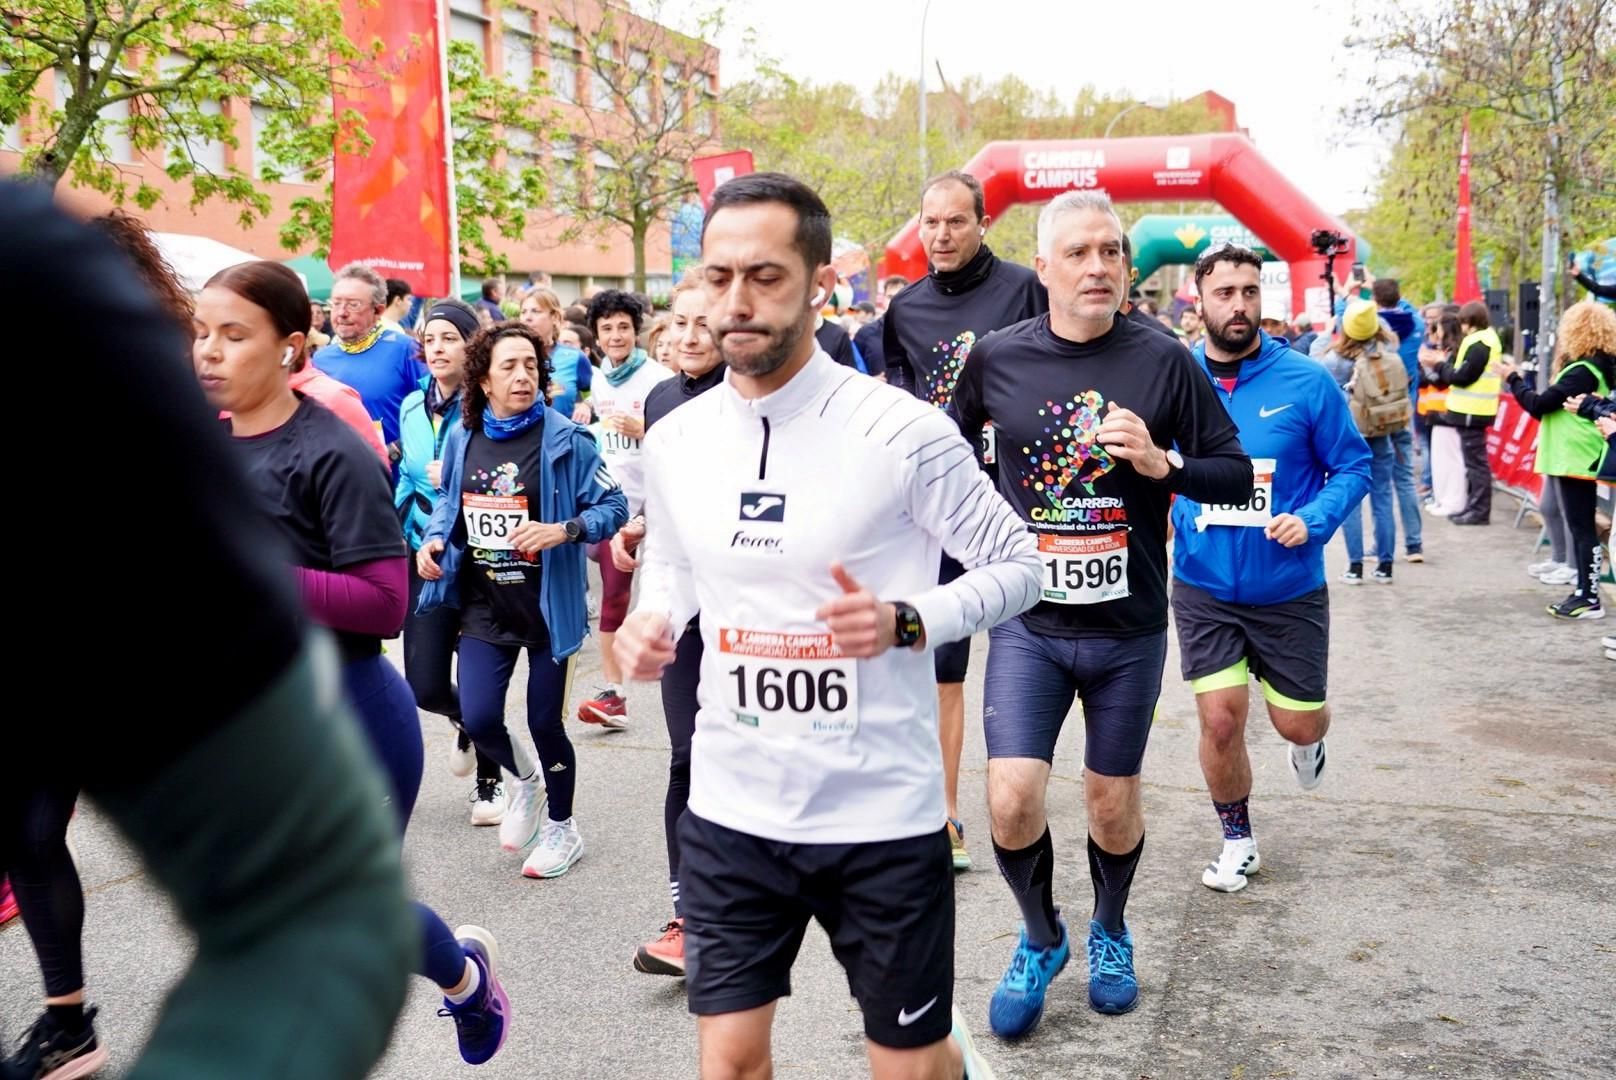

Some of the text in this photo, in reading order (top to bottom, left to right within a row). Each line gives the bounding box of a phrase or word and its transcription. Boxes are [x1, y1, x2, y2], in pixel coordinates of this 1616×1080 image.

[1024, 150, 1105, 169] CARRERA
[1024, 169, 1098, 188] CAMPUS
[1062, 497, 1124, 509] CARRERA
[1031, 508, 1128, 522] CAMPUS UR
[468, 511, 522, 537] 1637
[1036, 522, 1075, 530] Universidad
[1046, 544, 1086, 552] UNIVERSIDAD
[1086, 536, 1113, 545] CAMPUS
[1046, 555, 1122, 589] 1596
[741, 631, 829, 649] CARRERA CAMPUS
[731, 643, 788, 658] UNIVERSIDAD
[788, 649, 801, 658] DE
[803, 649, 816, 658] LA
[729, 665, 848, 713] 1606
